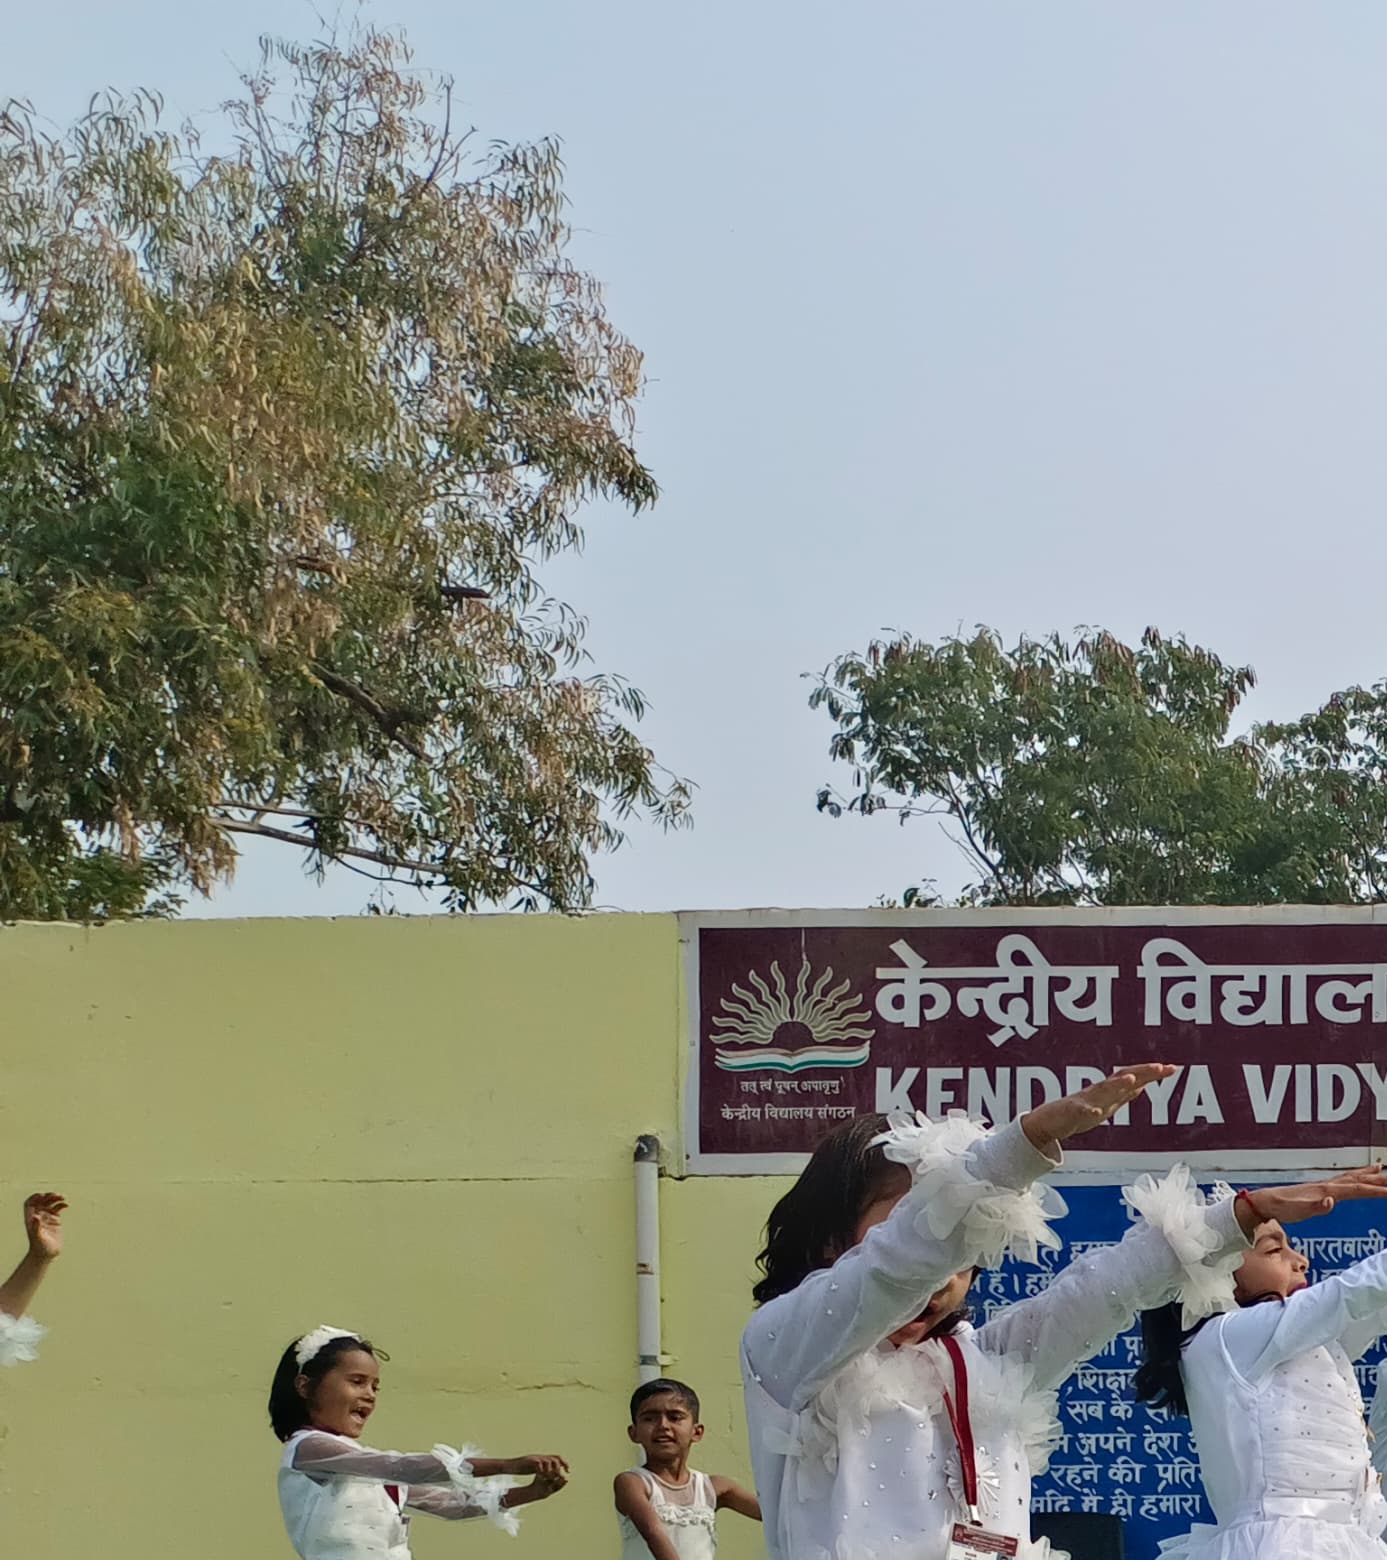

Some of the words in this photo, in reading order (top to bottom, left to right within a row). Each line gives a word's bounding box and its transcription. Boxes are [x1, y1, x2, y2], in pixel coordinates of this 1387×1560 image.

[875, 933, 1120, 1048] केन्द्रीय
[721, 1103, 761, 1121] केन्द्रीय
[764, 1103, 814, 1120] विद्यालय
[816, 1103, 856, 1120] संगठन
[1075, 1426, 1137, 1455] अपने
[1108, 1455, 1147, 1484] की
